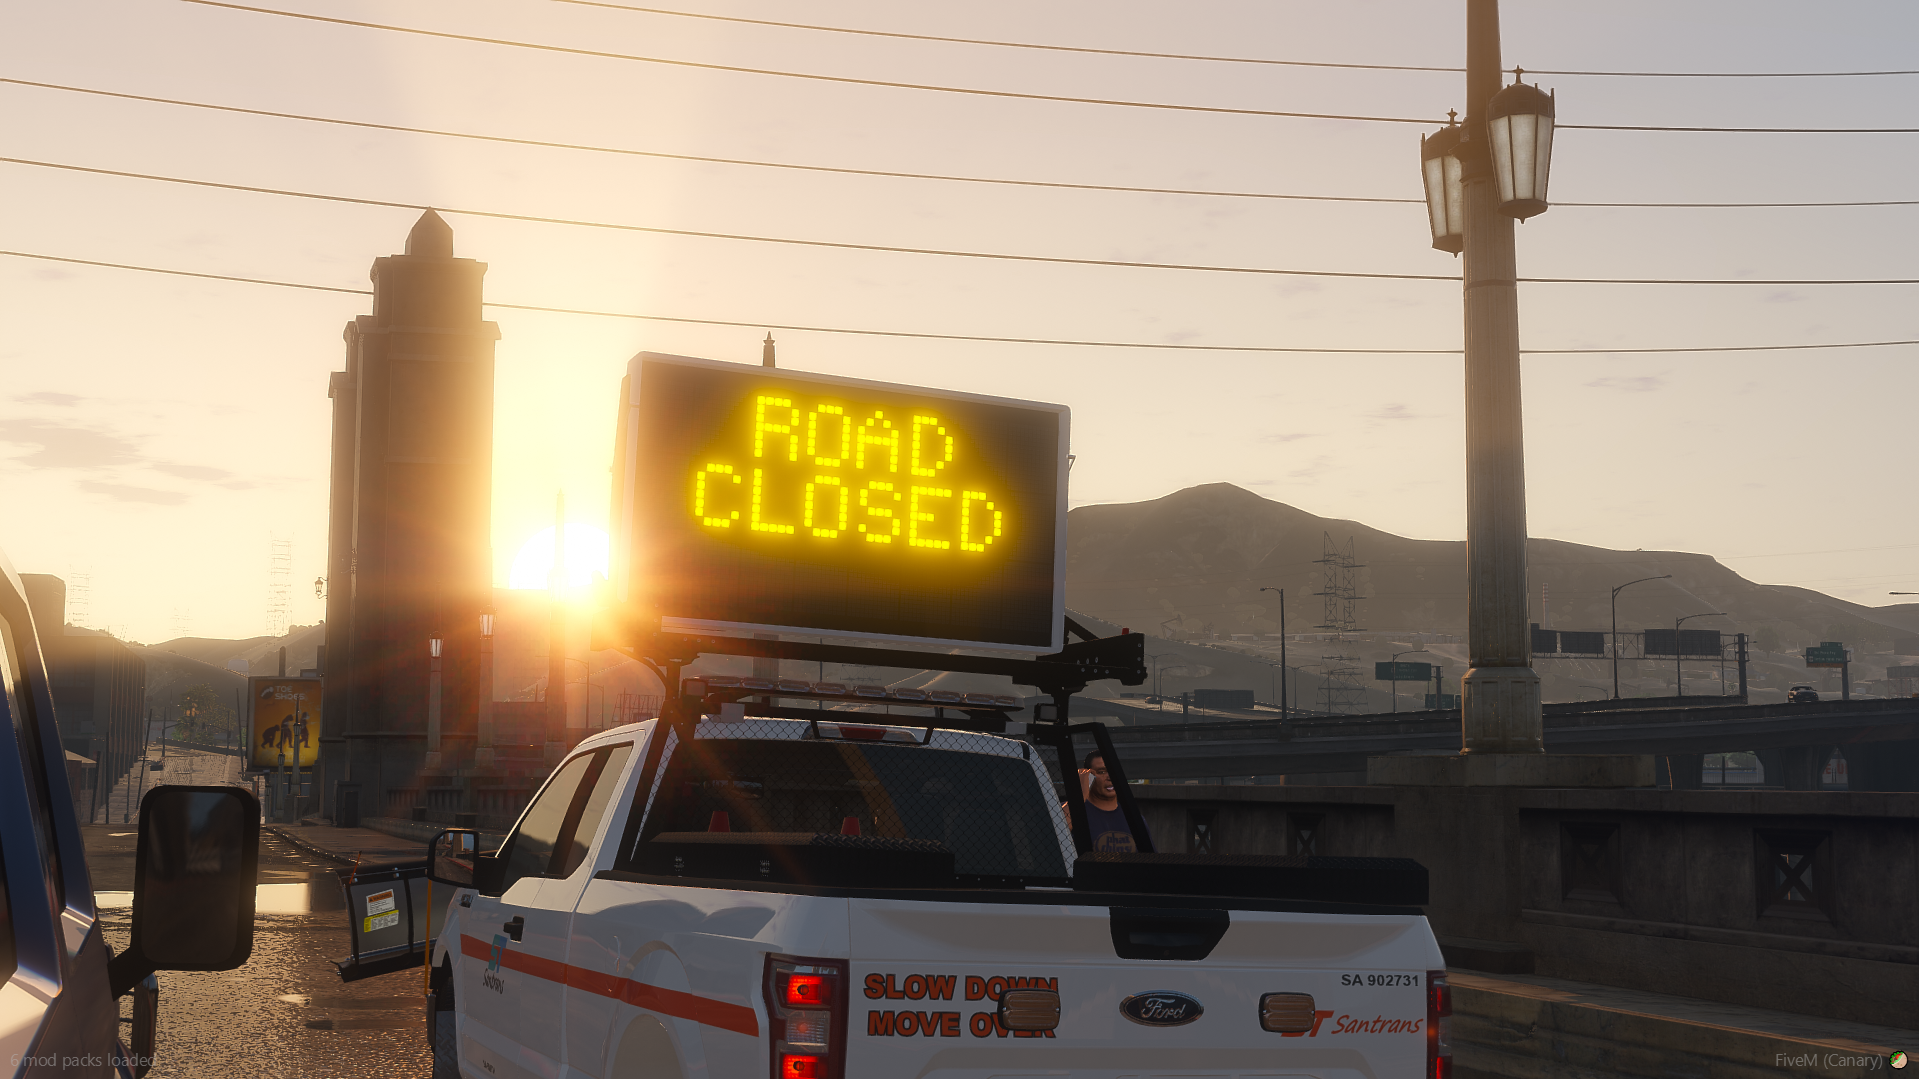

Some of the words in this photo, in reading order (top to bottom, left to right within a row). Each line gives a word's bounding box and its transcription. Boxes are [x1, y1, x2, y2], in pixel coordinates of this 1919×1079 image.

[754, 395, 954, 478] ROAD
[694, 463, 1003, 552] CLOSED
[274, 692, 306, 700] SHOES
[275, 685, 293, 693] TOE
[1106, 832, 1130, 846] phat
[863, 973, 958, 1001] SLOW
[1341, 974, 1363, 987] SA
[1367, 974, 1419, 987] 902731
[1141, 997, 1187, 1019] Ford
[867, 1010, 961, 1038] MOVE
[1331, 1014, 1424, 1035] Santrans
